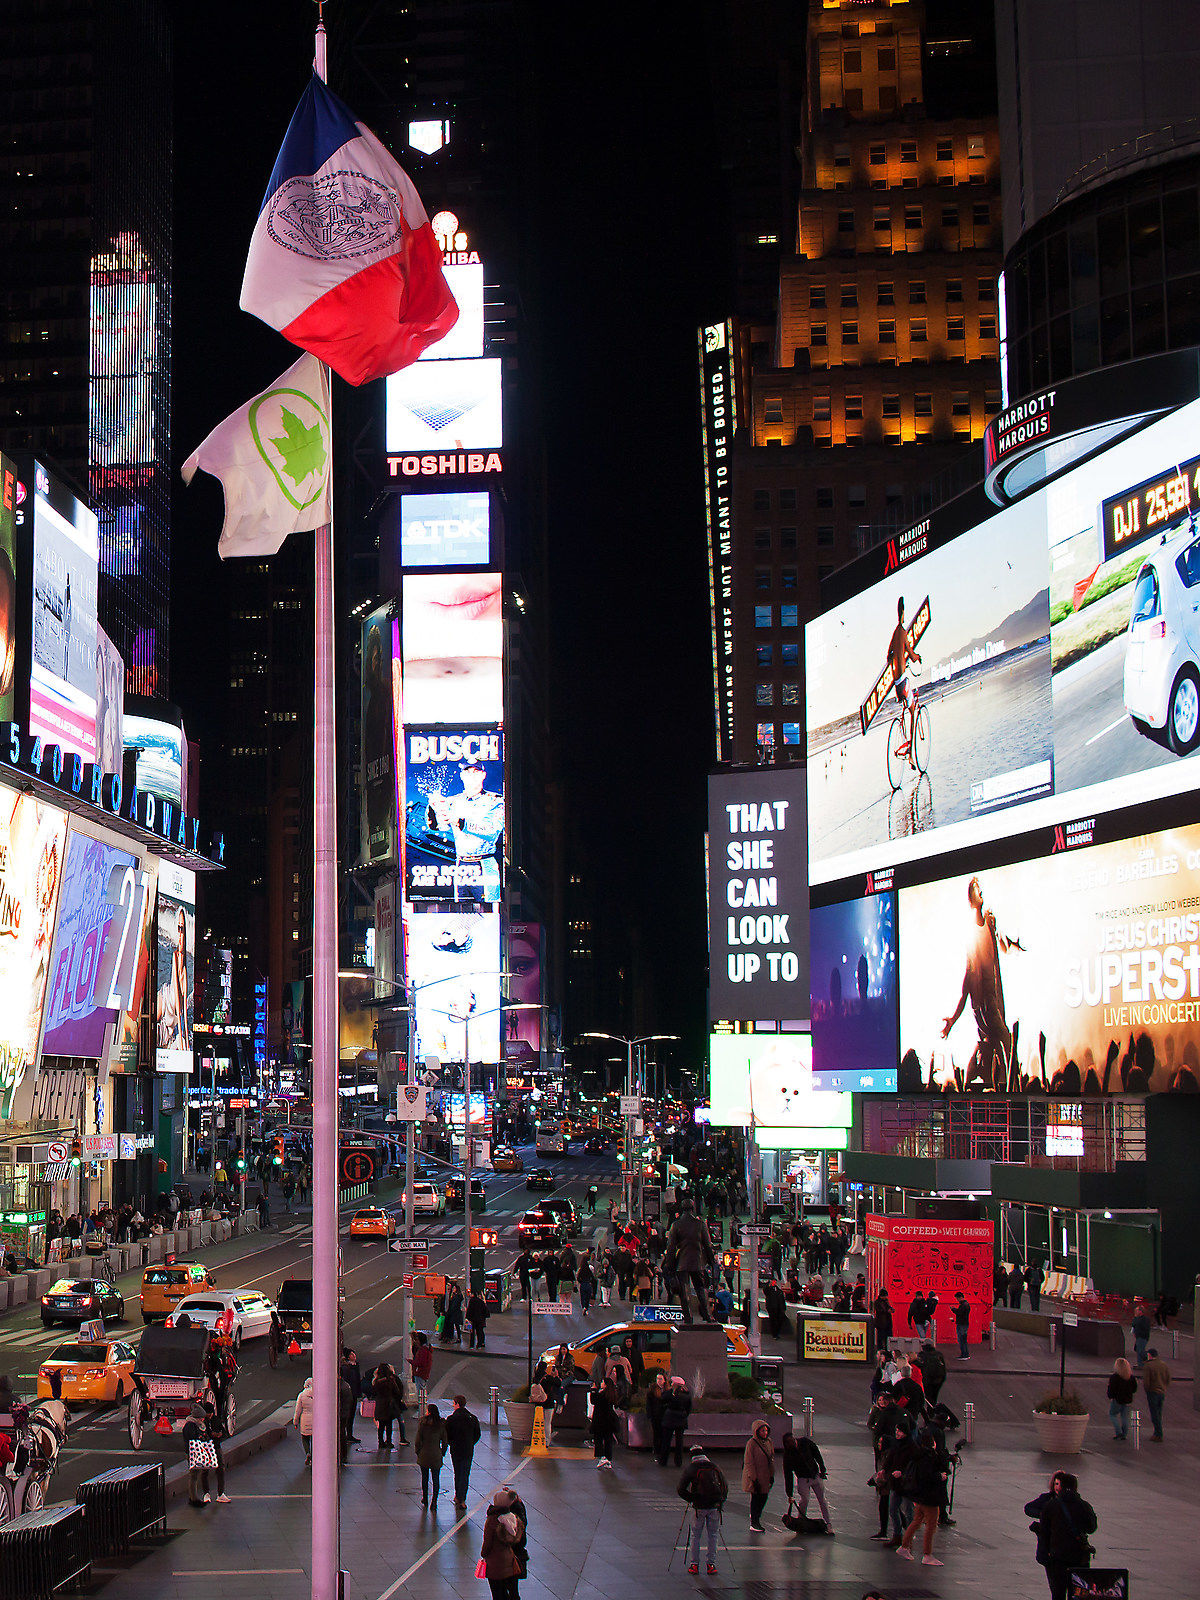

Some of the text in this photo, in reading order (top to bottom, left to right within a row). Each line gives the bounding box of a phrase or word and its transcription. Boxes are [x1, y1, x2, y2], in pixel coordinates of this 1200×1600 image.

[442, 252, 481, 265] HIBA
[712, 365, 725, 428] BORED.
[998, 391, 1056, 433] MARRIOTT
[715, 436, 726, 458] BE
[999, 416, 1048, 454] MARQUIS
[387, 453, 502, 476] TOSHIBA
[718, 466, 728, 492] TO
[718, 496, 731, 555] MEANT
[899, 519, 930, 547] MARRIOTT
[1113, 498, 1140, 542] DJI
[899, 537, 927, 562] MARQUIS
[721, 565, 732, 597] NOT
[409, 735, 499, 764] BUSCH
[71, 753, 200, 853] BROADWAY
[725, 800, 789, 833] THAT
[726, 840, 774, 871] SHE
[726, 876, 778, 909] CAN
[109, 863, 149, 1012] 21
[726, 914, 790, 946] LOOK
[1099, 921, 1146, 953] JESUS
[727, 951, 799, 983] UP TO
[1104, 1007, 1128, 1027] LIVE
[1129, 1006, 1142, 1026] IN
[893, 1226, 990, 1236] COFFEED SWEET CHURROS
[806, 1331, 864, 1346] Beautiful
